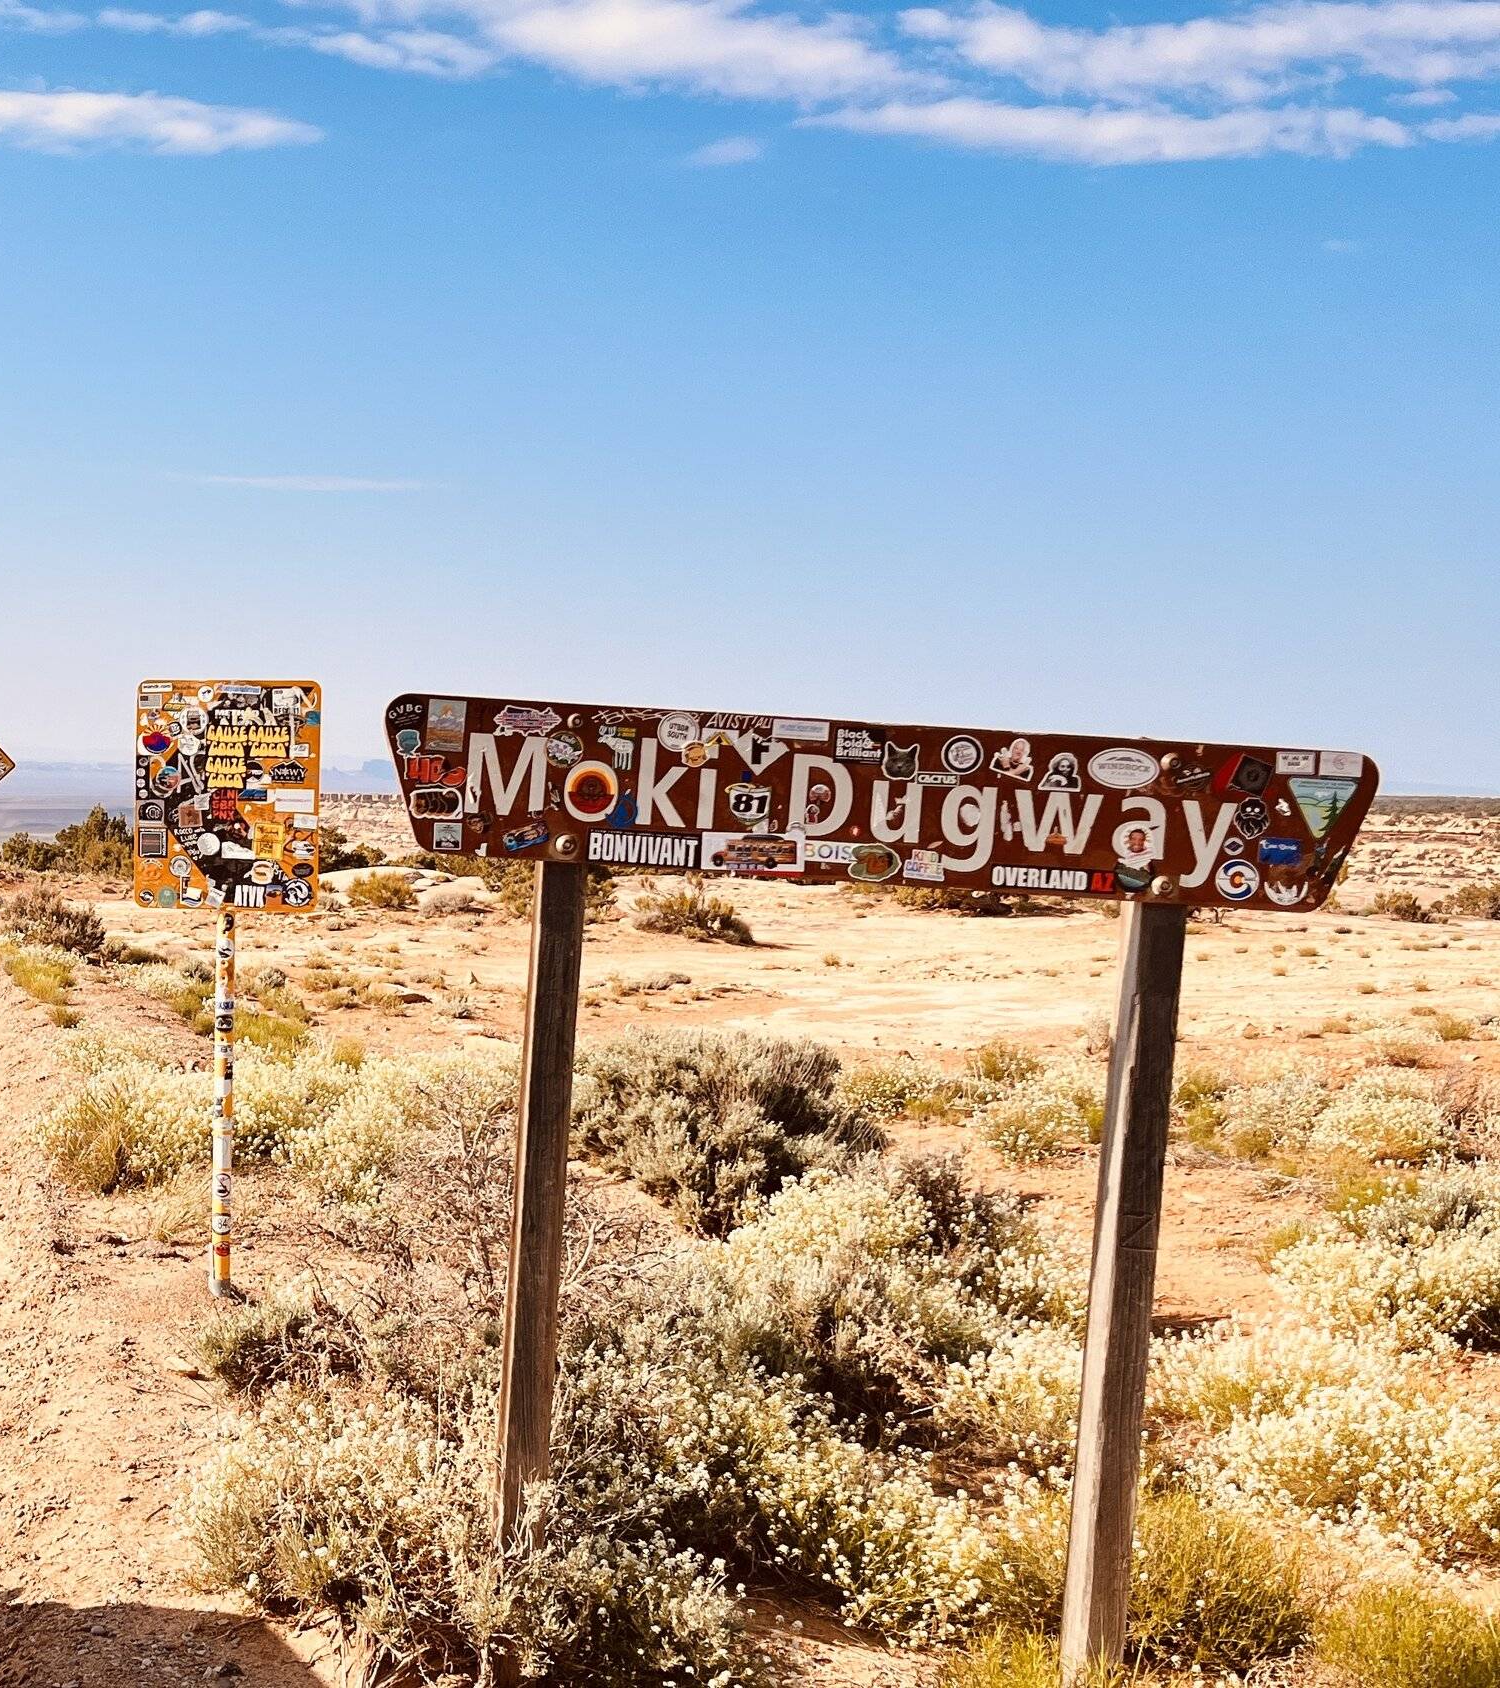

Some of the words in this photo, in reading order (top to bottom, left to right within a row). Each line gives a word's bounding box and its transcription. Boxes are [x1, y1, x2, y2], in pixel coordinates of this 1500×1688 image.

[666, 730, 688, 740] SOUTH
[837, 728, 870, 739] Black
[835, 748, 882, 759] Brilliant
[918, 774, 957, 785] CACTUS
[464, 732, 718, 829] Moki
[788, 753, 1238, 888] Dugway
[732, 794, 768, 814] 81
[588, 832, 699, 868] BONVIVANT
[991, 865, 1088, 891] OVERLAND
[1091, 872, 1115, 891] AZ
